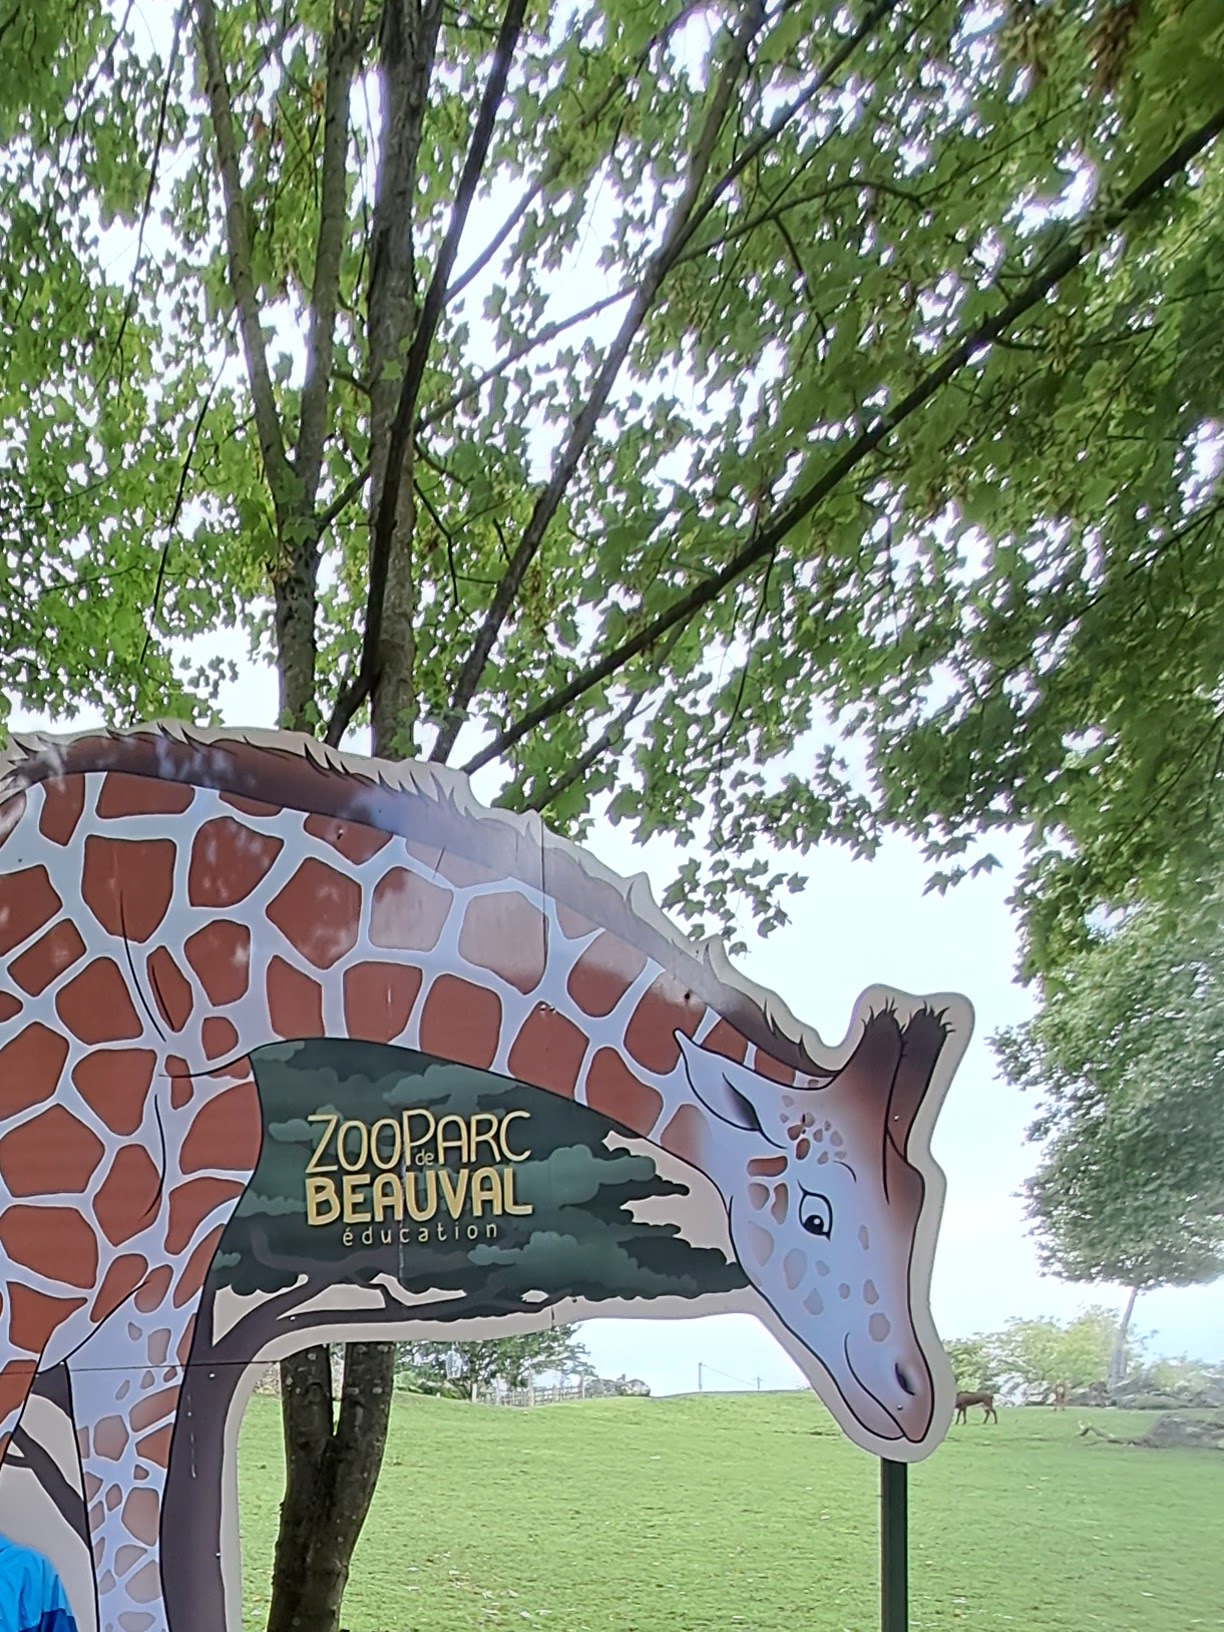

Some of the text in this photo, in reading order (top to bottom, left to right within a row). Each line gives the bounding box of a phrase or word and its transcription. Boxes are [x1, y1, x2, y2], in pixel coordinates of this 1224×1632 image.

[414, 1148, 434, 1166] de
[305, 1166, 534, 1226] BEAUVAL
[342, 1222, 498, 1247] éducation
